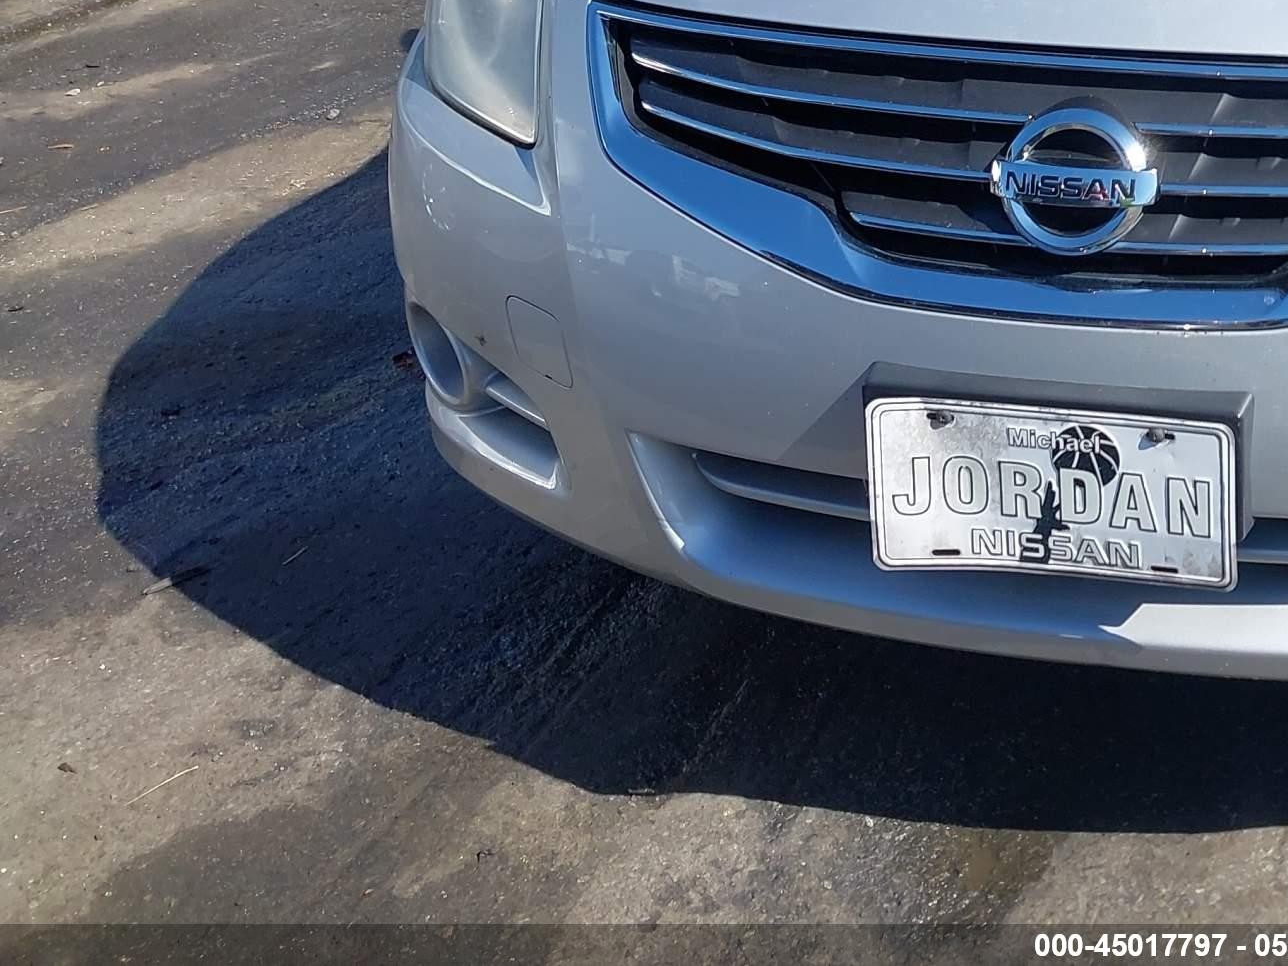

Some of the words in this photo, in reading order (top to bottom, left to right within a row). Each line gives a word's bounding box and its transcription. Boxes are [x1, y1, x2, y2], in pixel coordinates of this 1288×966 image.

[1005, 170, 1137, 203] NISSAN
[1006, 426, 1102, 455] Michael
[891, 455, 1213, 539] JORDAN
[970, 527, 1143, 569] NISSAN
